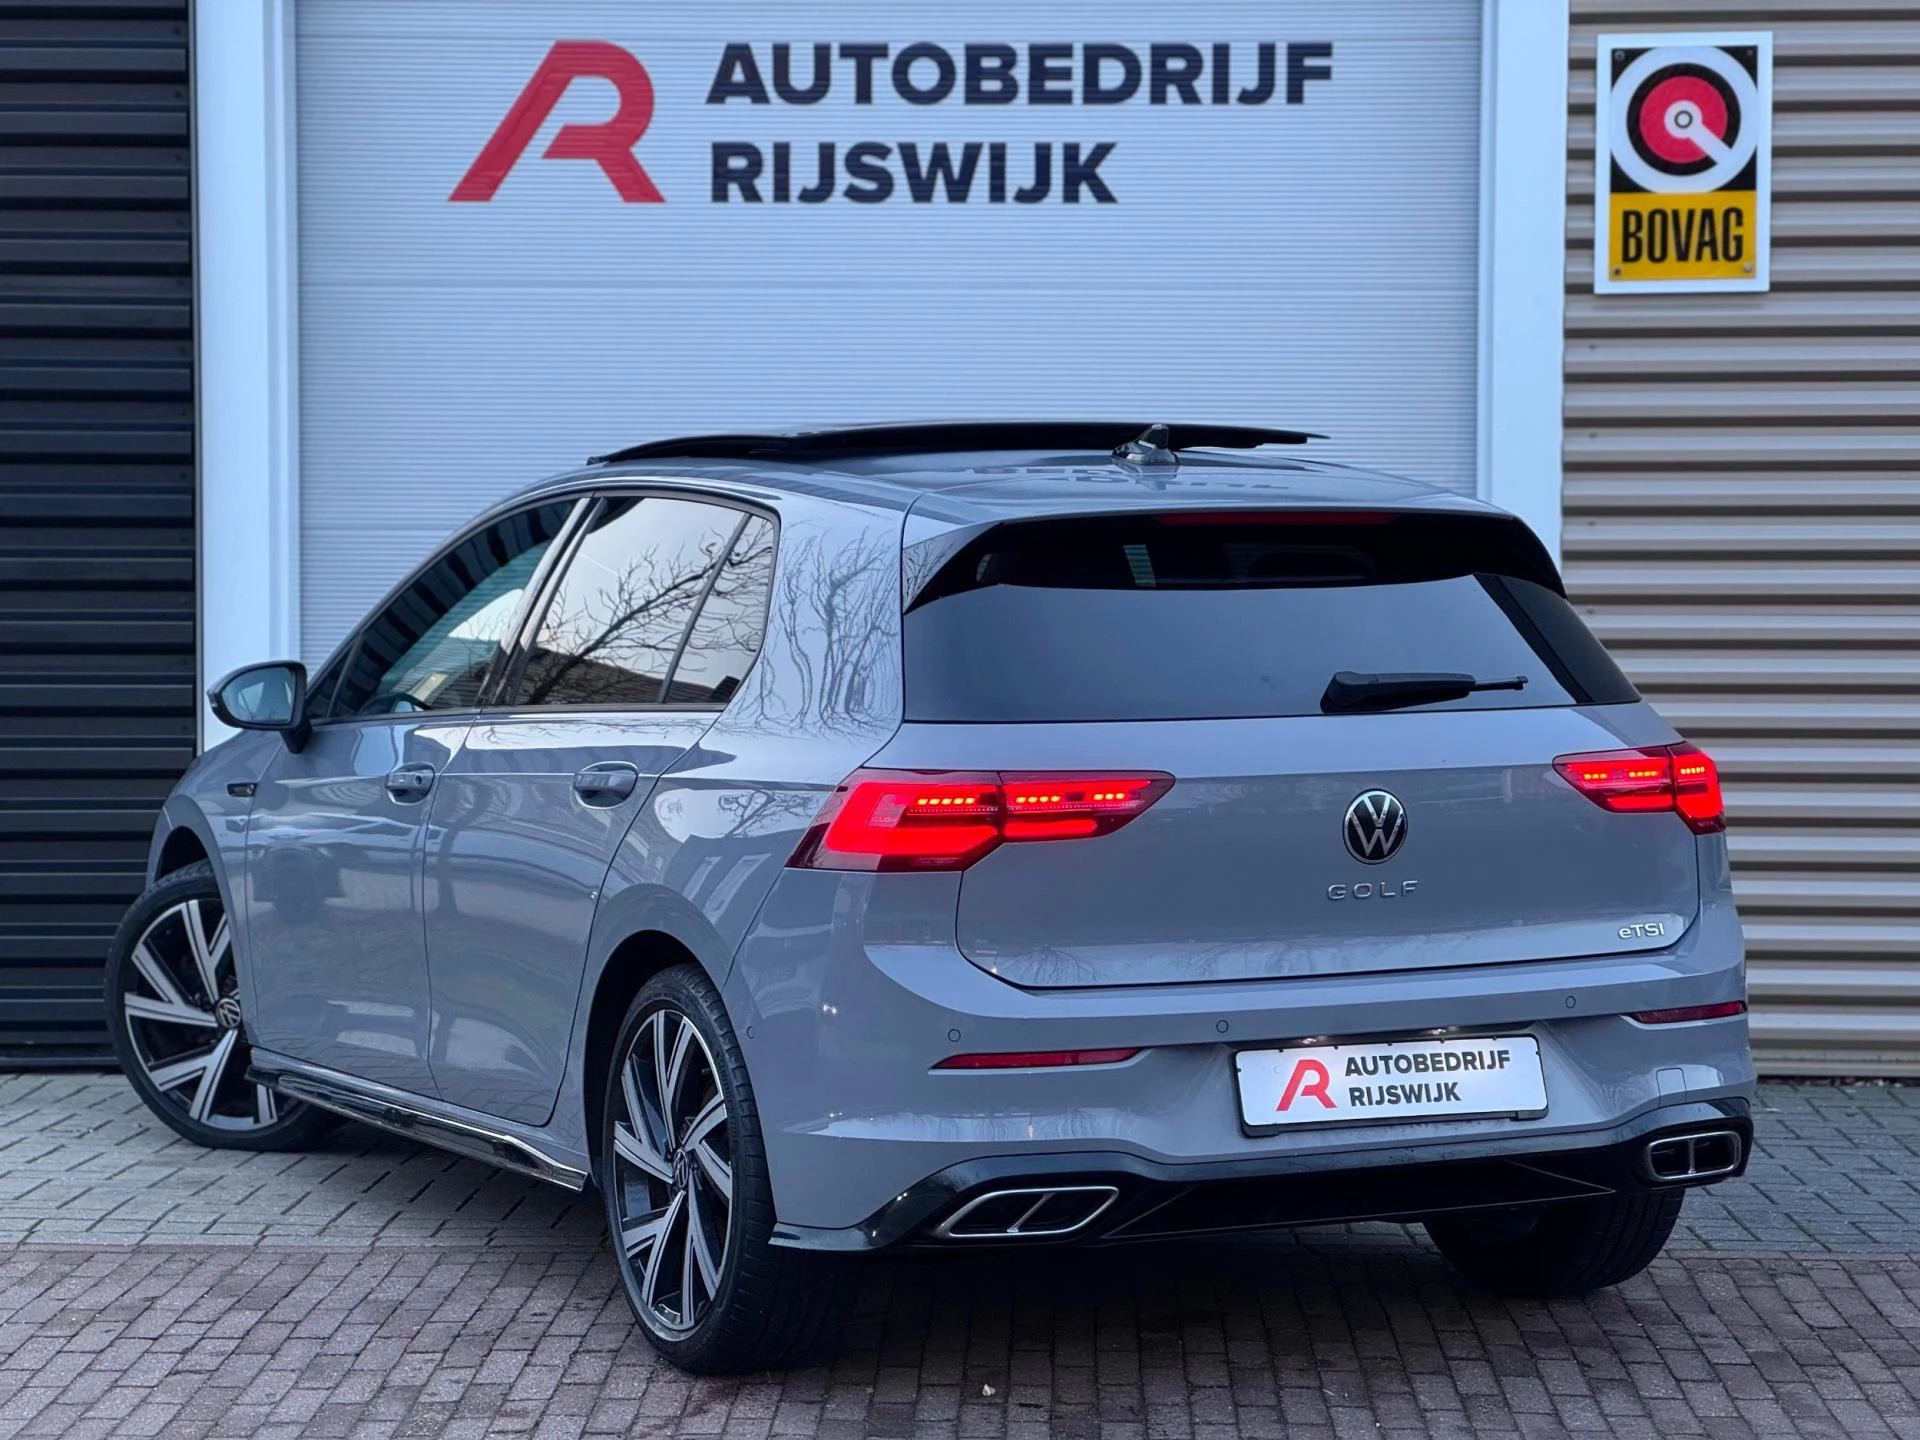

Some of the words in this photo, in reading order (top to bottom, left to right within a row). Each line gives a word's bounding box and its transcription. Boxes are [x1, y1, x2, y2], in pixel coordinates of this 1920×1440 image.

[706, 42, 1333, 106] AUTOBEDRIJF
[711, 141, 1118, 205] RIJSWIJK
[1621, 206, 1744, 264] BOVAG
[1327, 880, 1419, 901] GOLF
[1618, 922, 1665, 939] eTSI
[1344, 1049, 1511, 1077] AUTOBEDRIJF
[1348, 1082, 1461, 1107] RIJSWIJK
